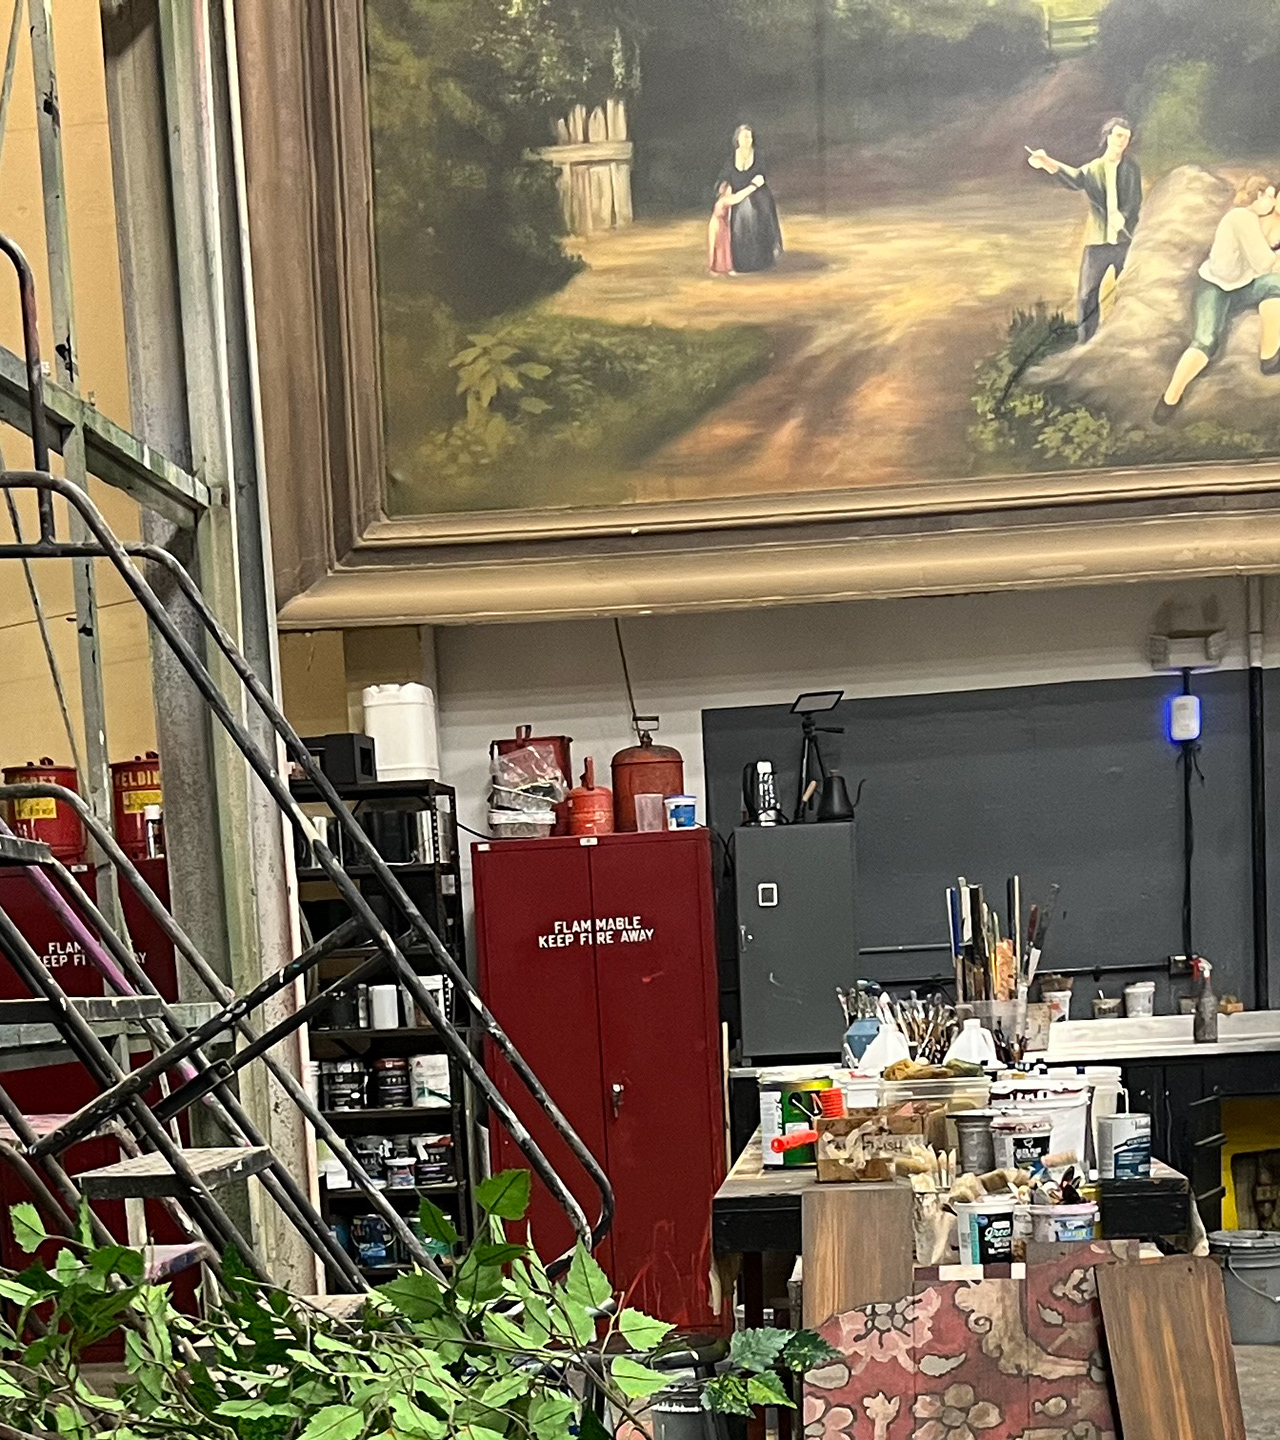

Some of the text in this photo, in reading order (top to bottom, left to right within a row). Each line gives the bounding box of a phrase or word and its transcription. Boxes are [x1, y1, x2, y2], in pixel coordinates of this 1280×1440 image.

[538, 934, 574, 948] KEEP
[620, 929, 654, 943] AWAY
[40, 954, 68, 968] EEP
